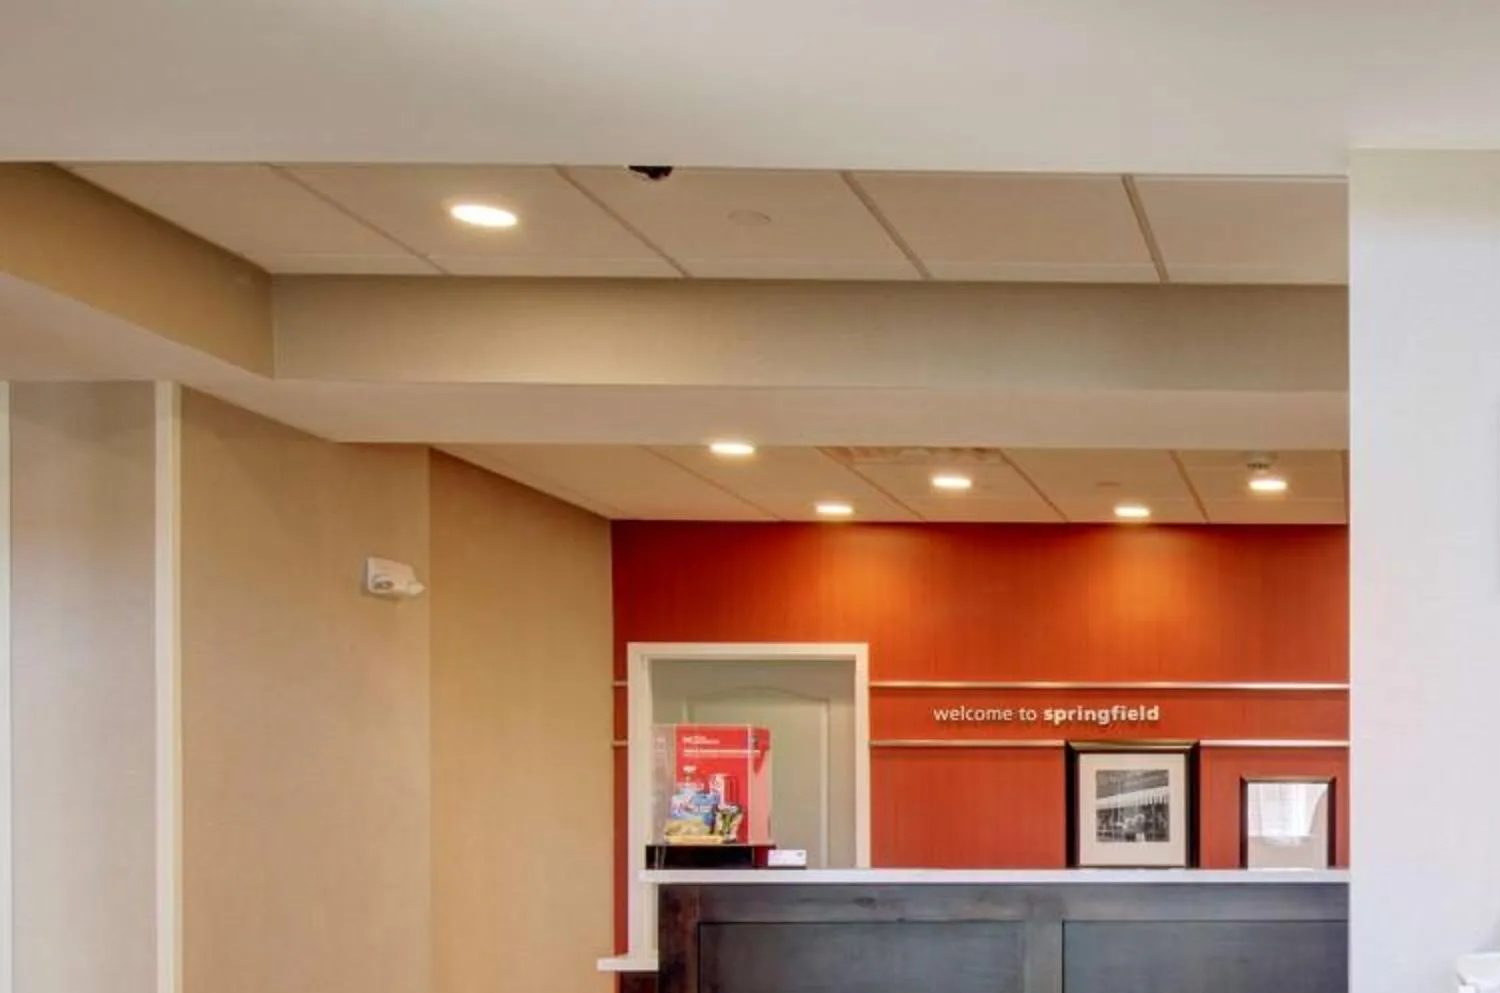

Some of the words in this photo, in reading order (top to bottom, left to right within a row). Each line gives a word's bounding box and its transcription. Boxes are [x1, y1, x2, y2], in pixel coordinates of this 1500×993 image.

[933, 704, 1013, 721] welcome
[1018, 706, 1037, 721] to
[1043, 704, 1160, 725] springfield
